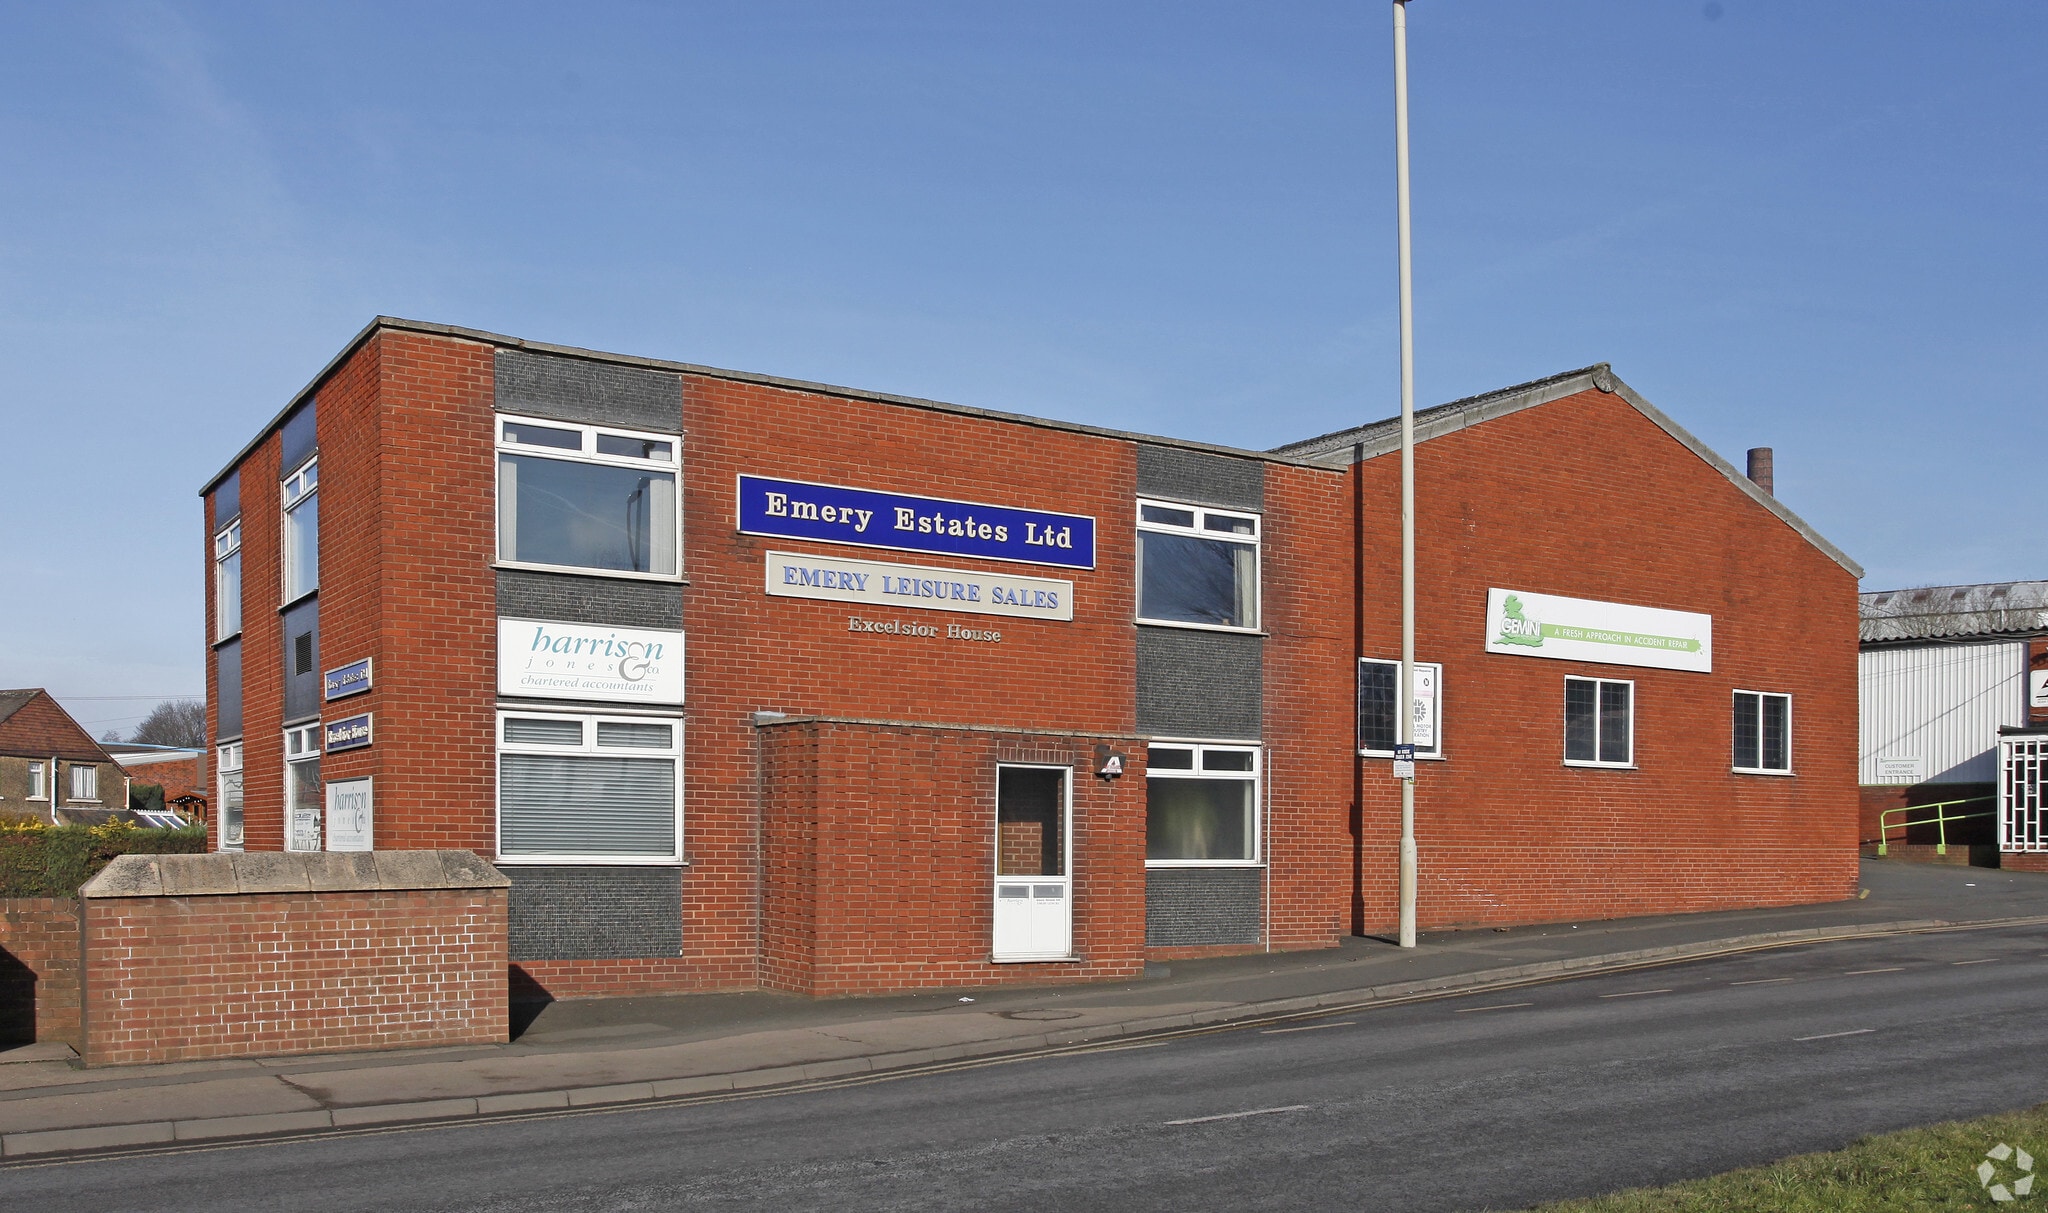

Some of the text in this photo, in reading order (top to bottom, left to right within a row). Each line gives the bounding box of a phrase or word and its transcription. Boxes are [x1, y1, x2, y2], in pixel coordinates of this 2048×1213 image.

[765, 491, 1072, 549] Emery Estates Ltd
[783, 565, 1059, 609] EMERY LEISURE SALES
[531, 626, 664, 660] harrison
[848, 616, 1001, 643] Excelsior House
[1554, 628, 1688, 649] A FRESH APPROACH IN ACCIDENT REPAIR
[521, 675, 654, 692] chartered accountants
